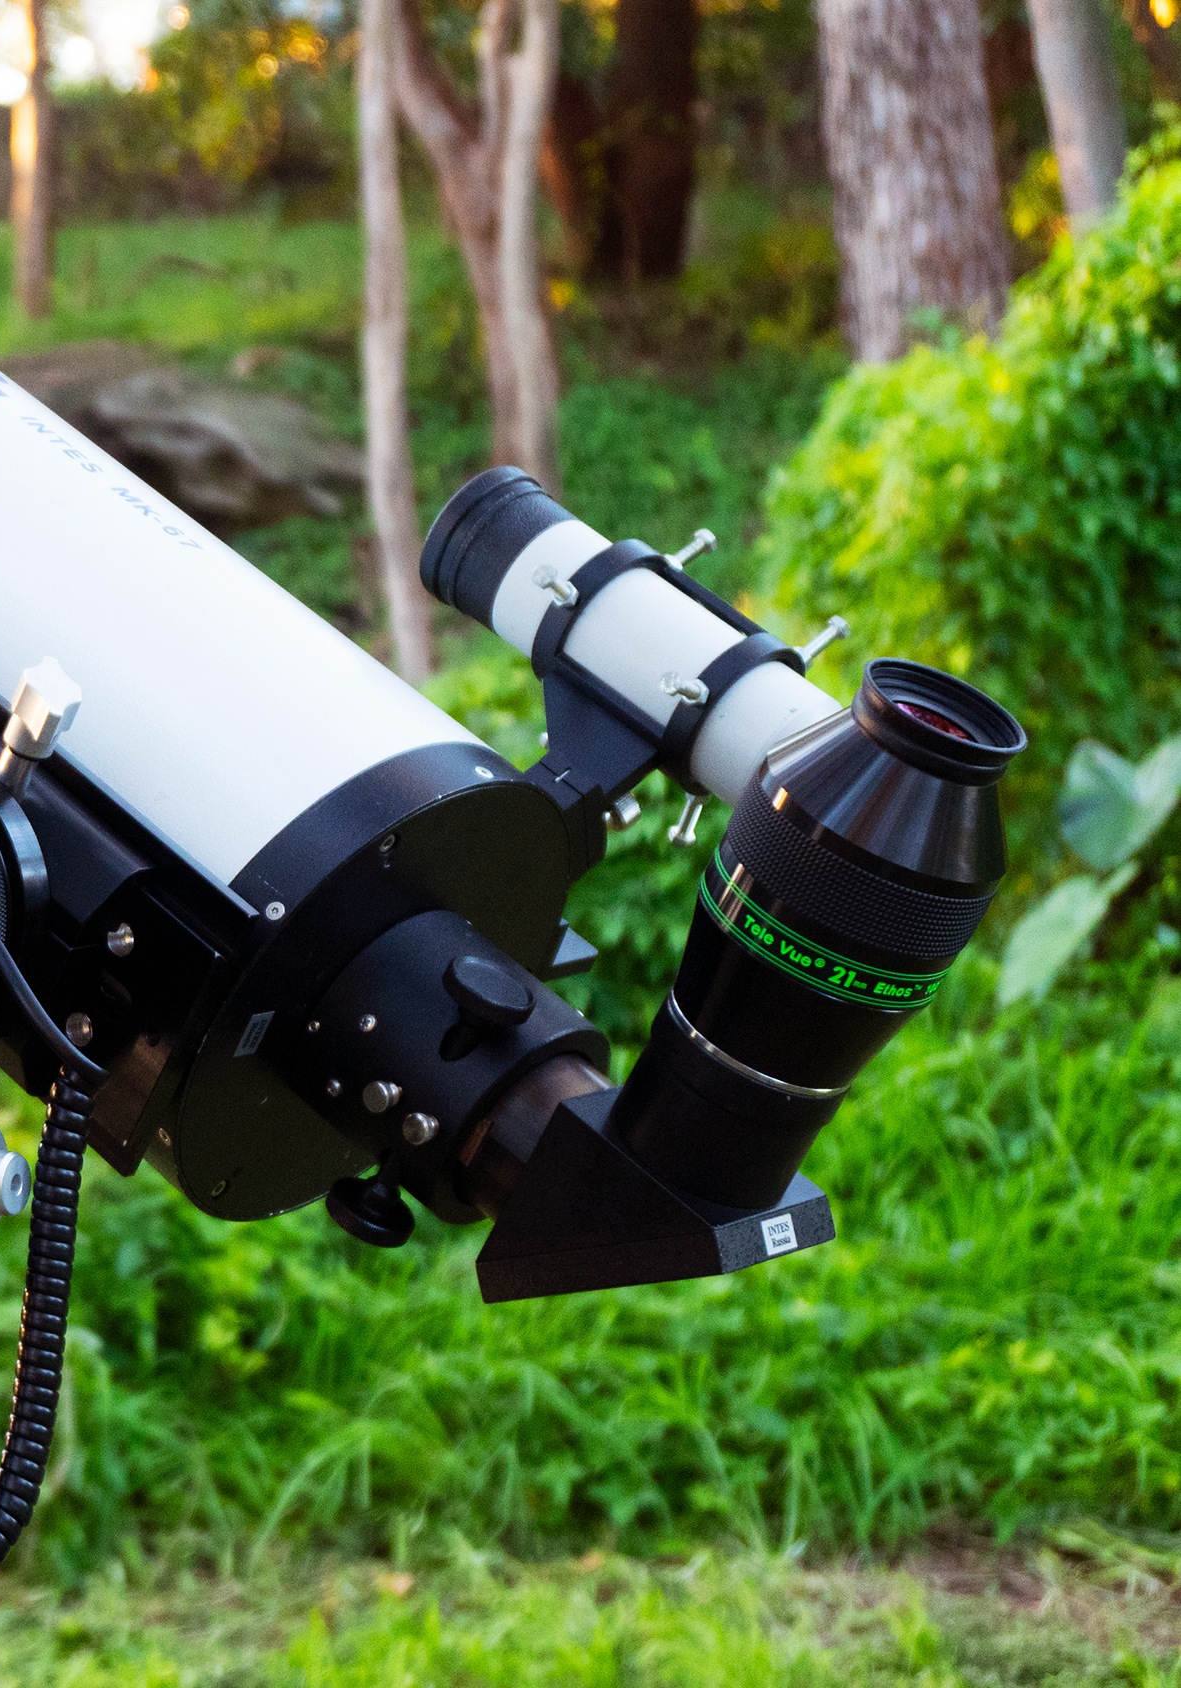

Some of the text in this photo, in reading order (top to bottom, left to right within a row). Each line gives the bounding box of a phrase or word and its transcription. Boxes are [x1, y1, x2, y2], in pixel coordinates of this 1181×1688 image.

[20, 416, 204, 550] INTES MK-67
[744, 914, 774, 945] Tele
[767, 1221, 790, 1236] INTES
